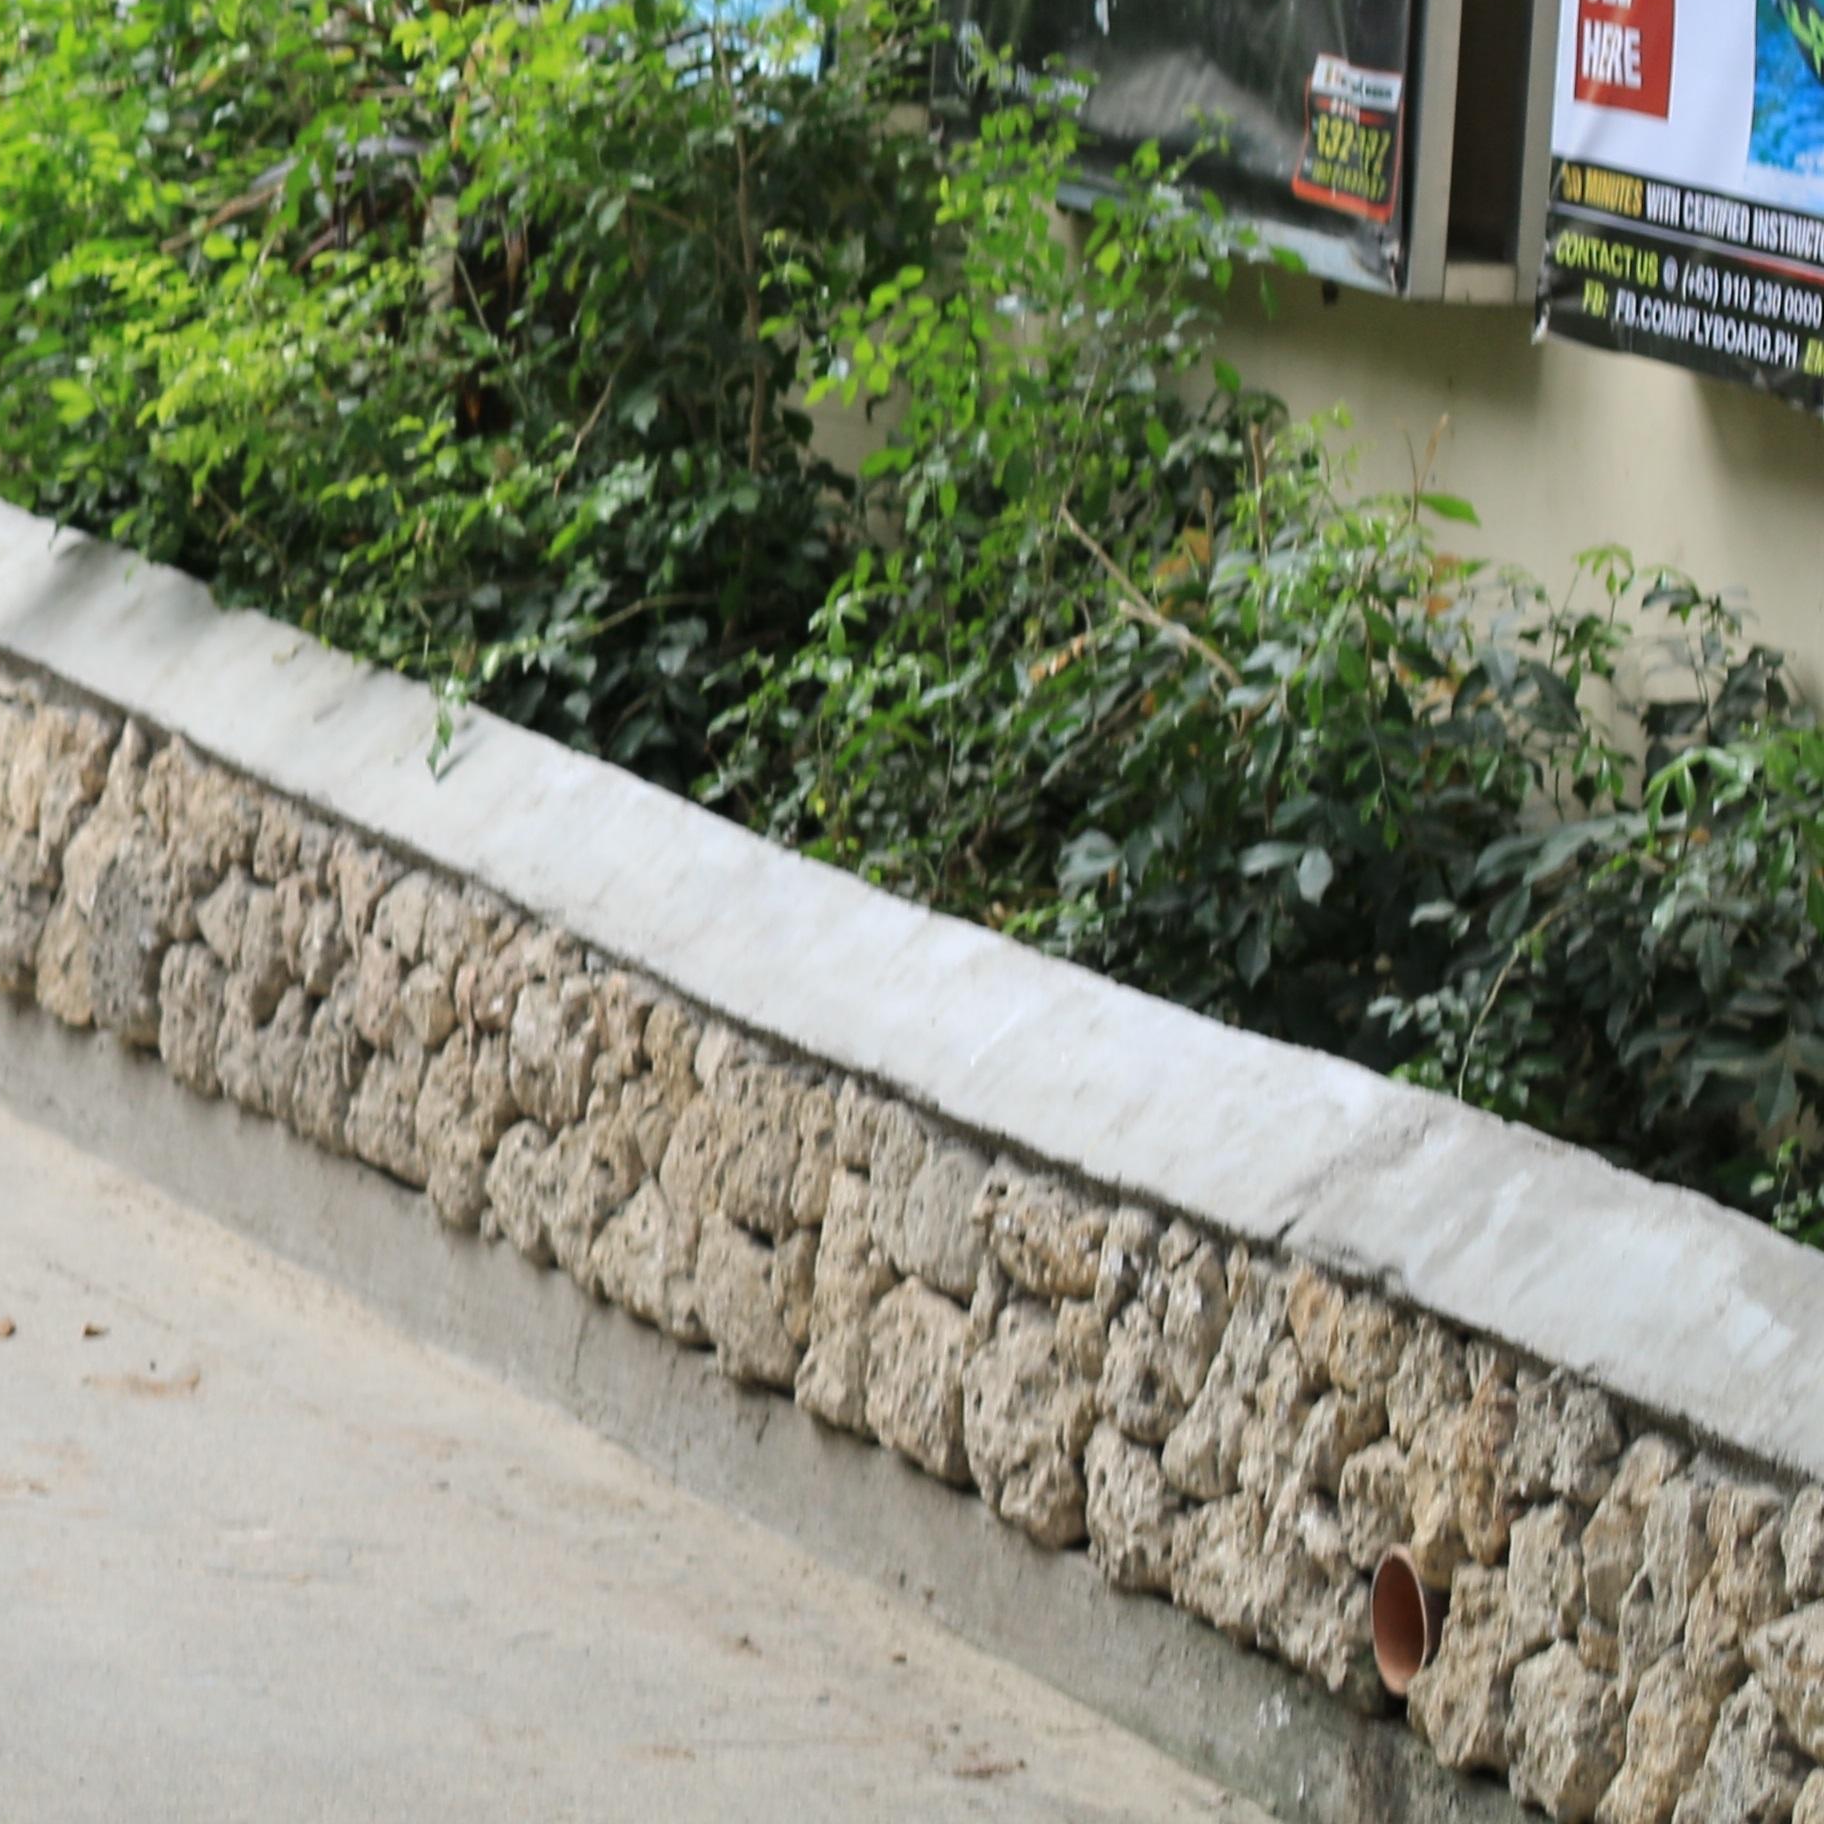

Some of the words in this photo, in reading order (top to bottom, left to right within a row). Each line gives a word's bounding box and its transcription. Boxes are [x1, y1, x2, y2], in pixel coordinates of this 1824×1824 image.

[1580, 16, 1643, 90] HERE
[1584, 163, 1645, 219] MINUTES
[1645, 180, 1682, 227] WITH
[1683, 188, 1751, 245] CERTIFIED
[1555, 227, 1635, 282] CONTACT
[1636, 246, 1660, 289] US
[1754, 279, 1782, 321] 230
[1783, 286, 1824, 328] 0000
